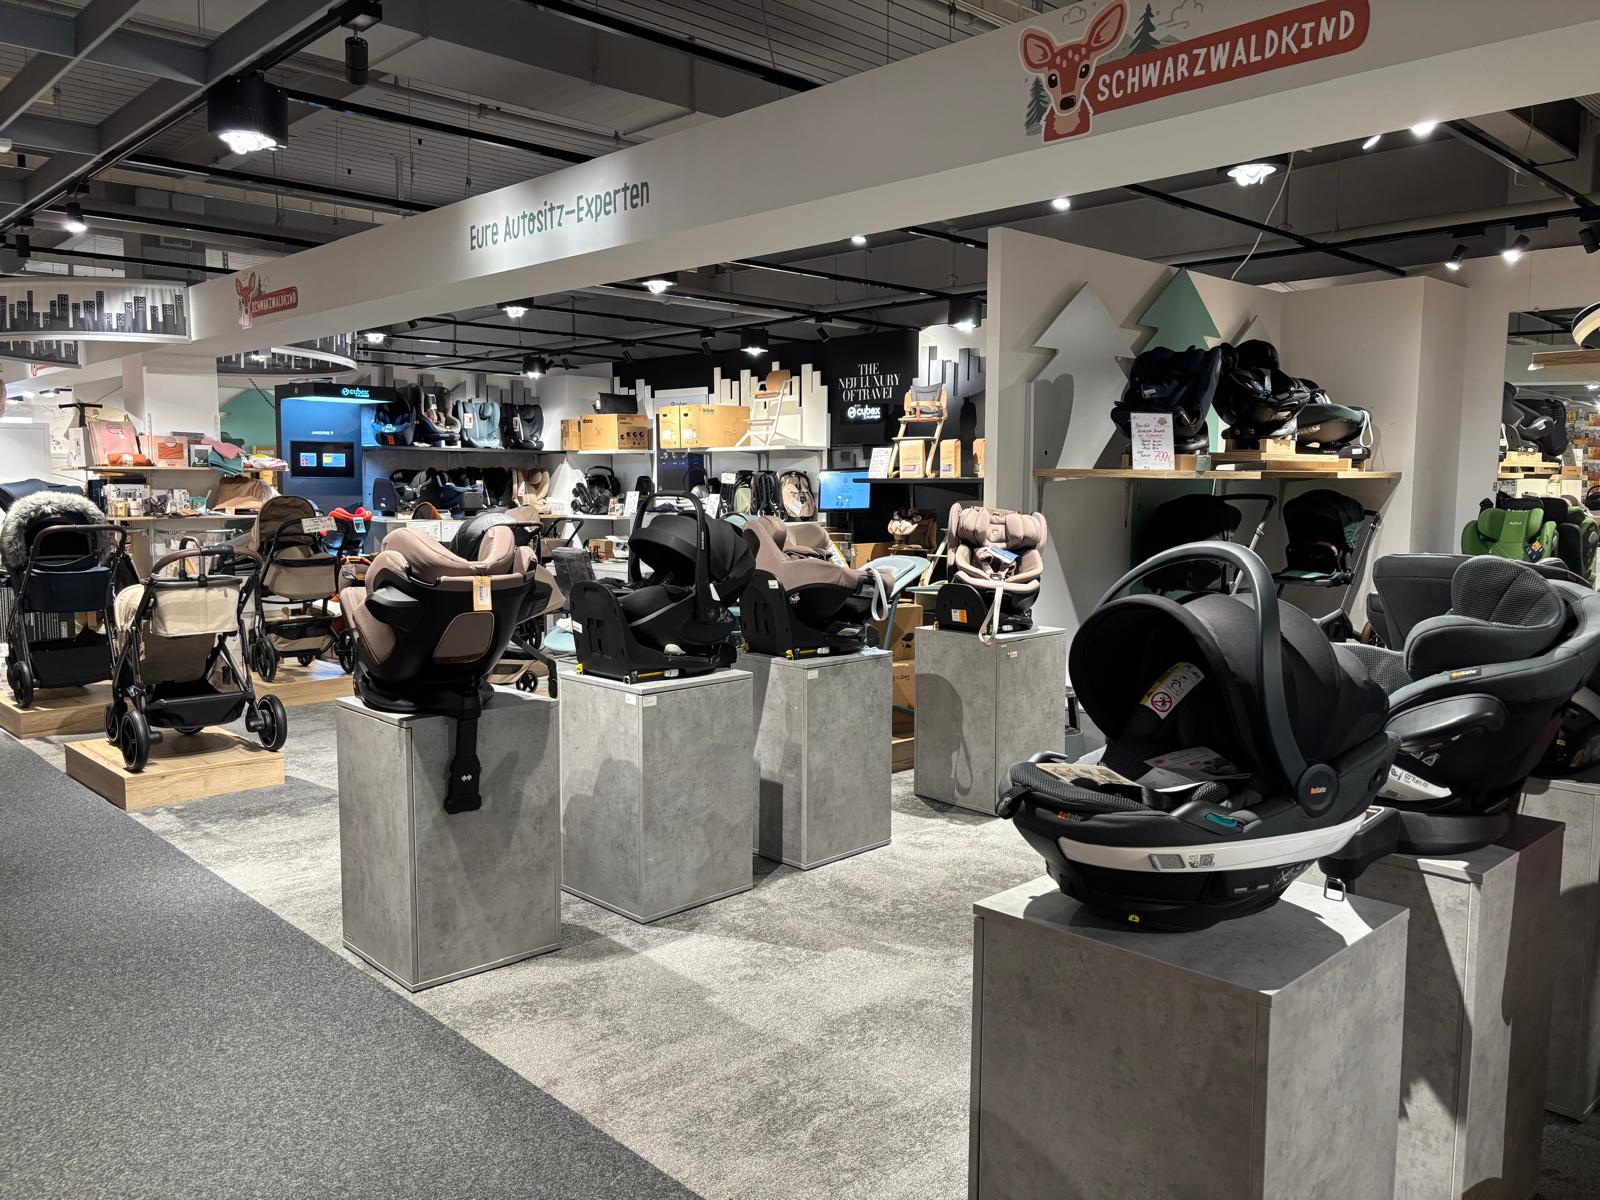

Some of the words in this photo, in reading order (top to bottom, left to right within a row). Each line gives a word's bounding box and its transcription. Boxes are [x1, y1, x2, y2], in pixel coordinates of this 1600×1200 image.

[1097, 10, 1355, 102] SCHWARZWALDKIND
[470, 221, 499, 251] Eure
[503, 180, 650, 243] Autositz-Experten
[858, 362, 880, 375] THE
[860, 374, 901, 388] LUXURY
[842, 389, 857, 402] OF
[856, 404, 881, 420] cybex
